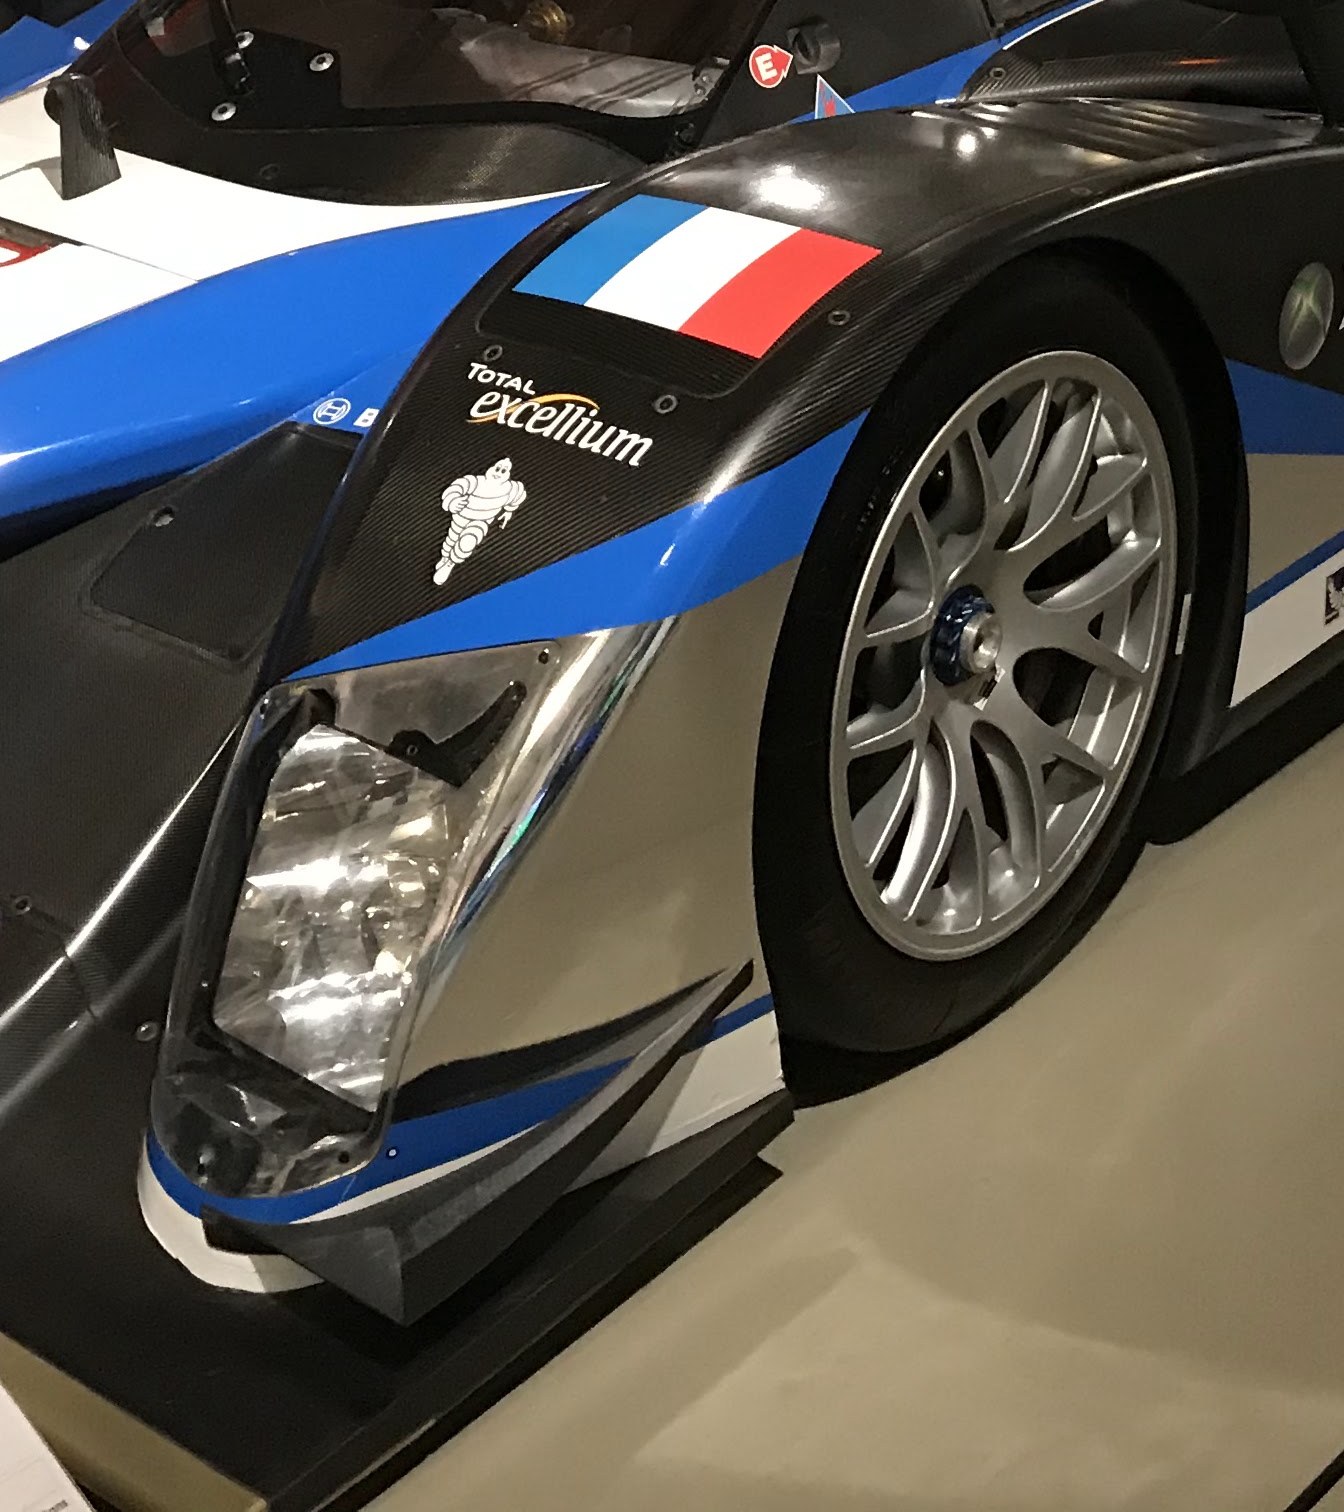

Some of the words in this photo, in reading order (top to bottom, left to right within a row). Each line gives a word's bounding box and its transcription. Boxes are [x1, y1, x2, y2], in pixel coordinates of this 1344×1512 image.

[755, 61, 778, 82] E
[467, 362, 536, 396] TOTAL
[470, 390, 653, 468] excellium
